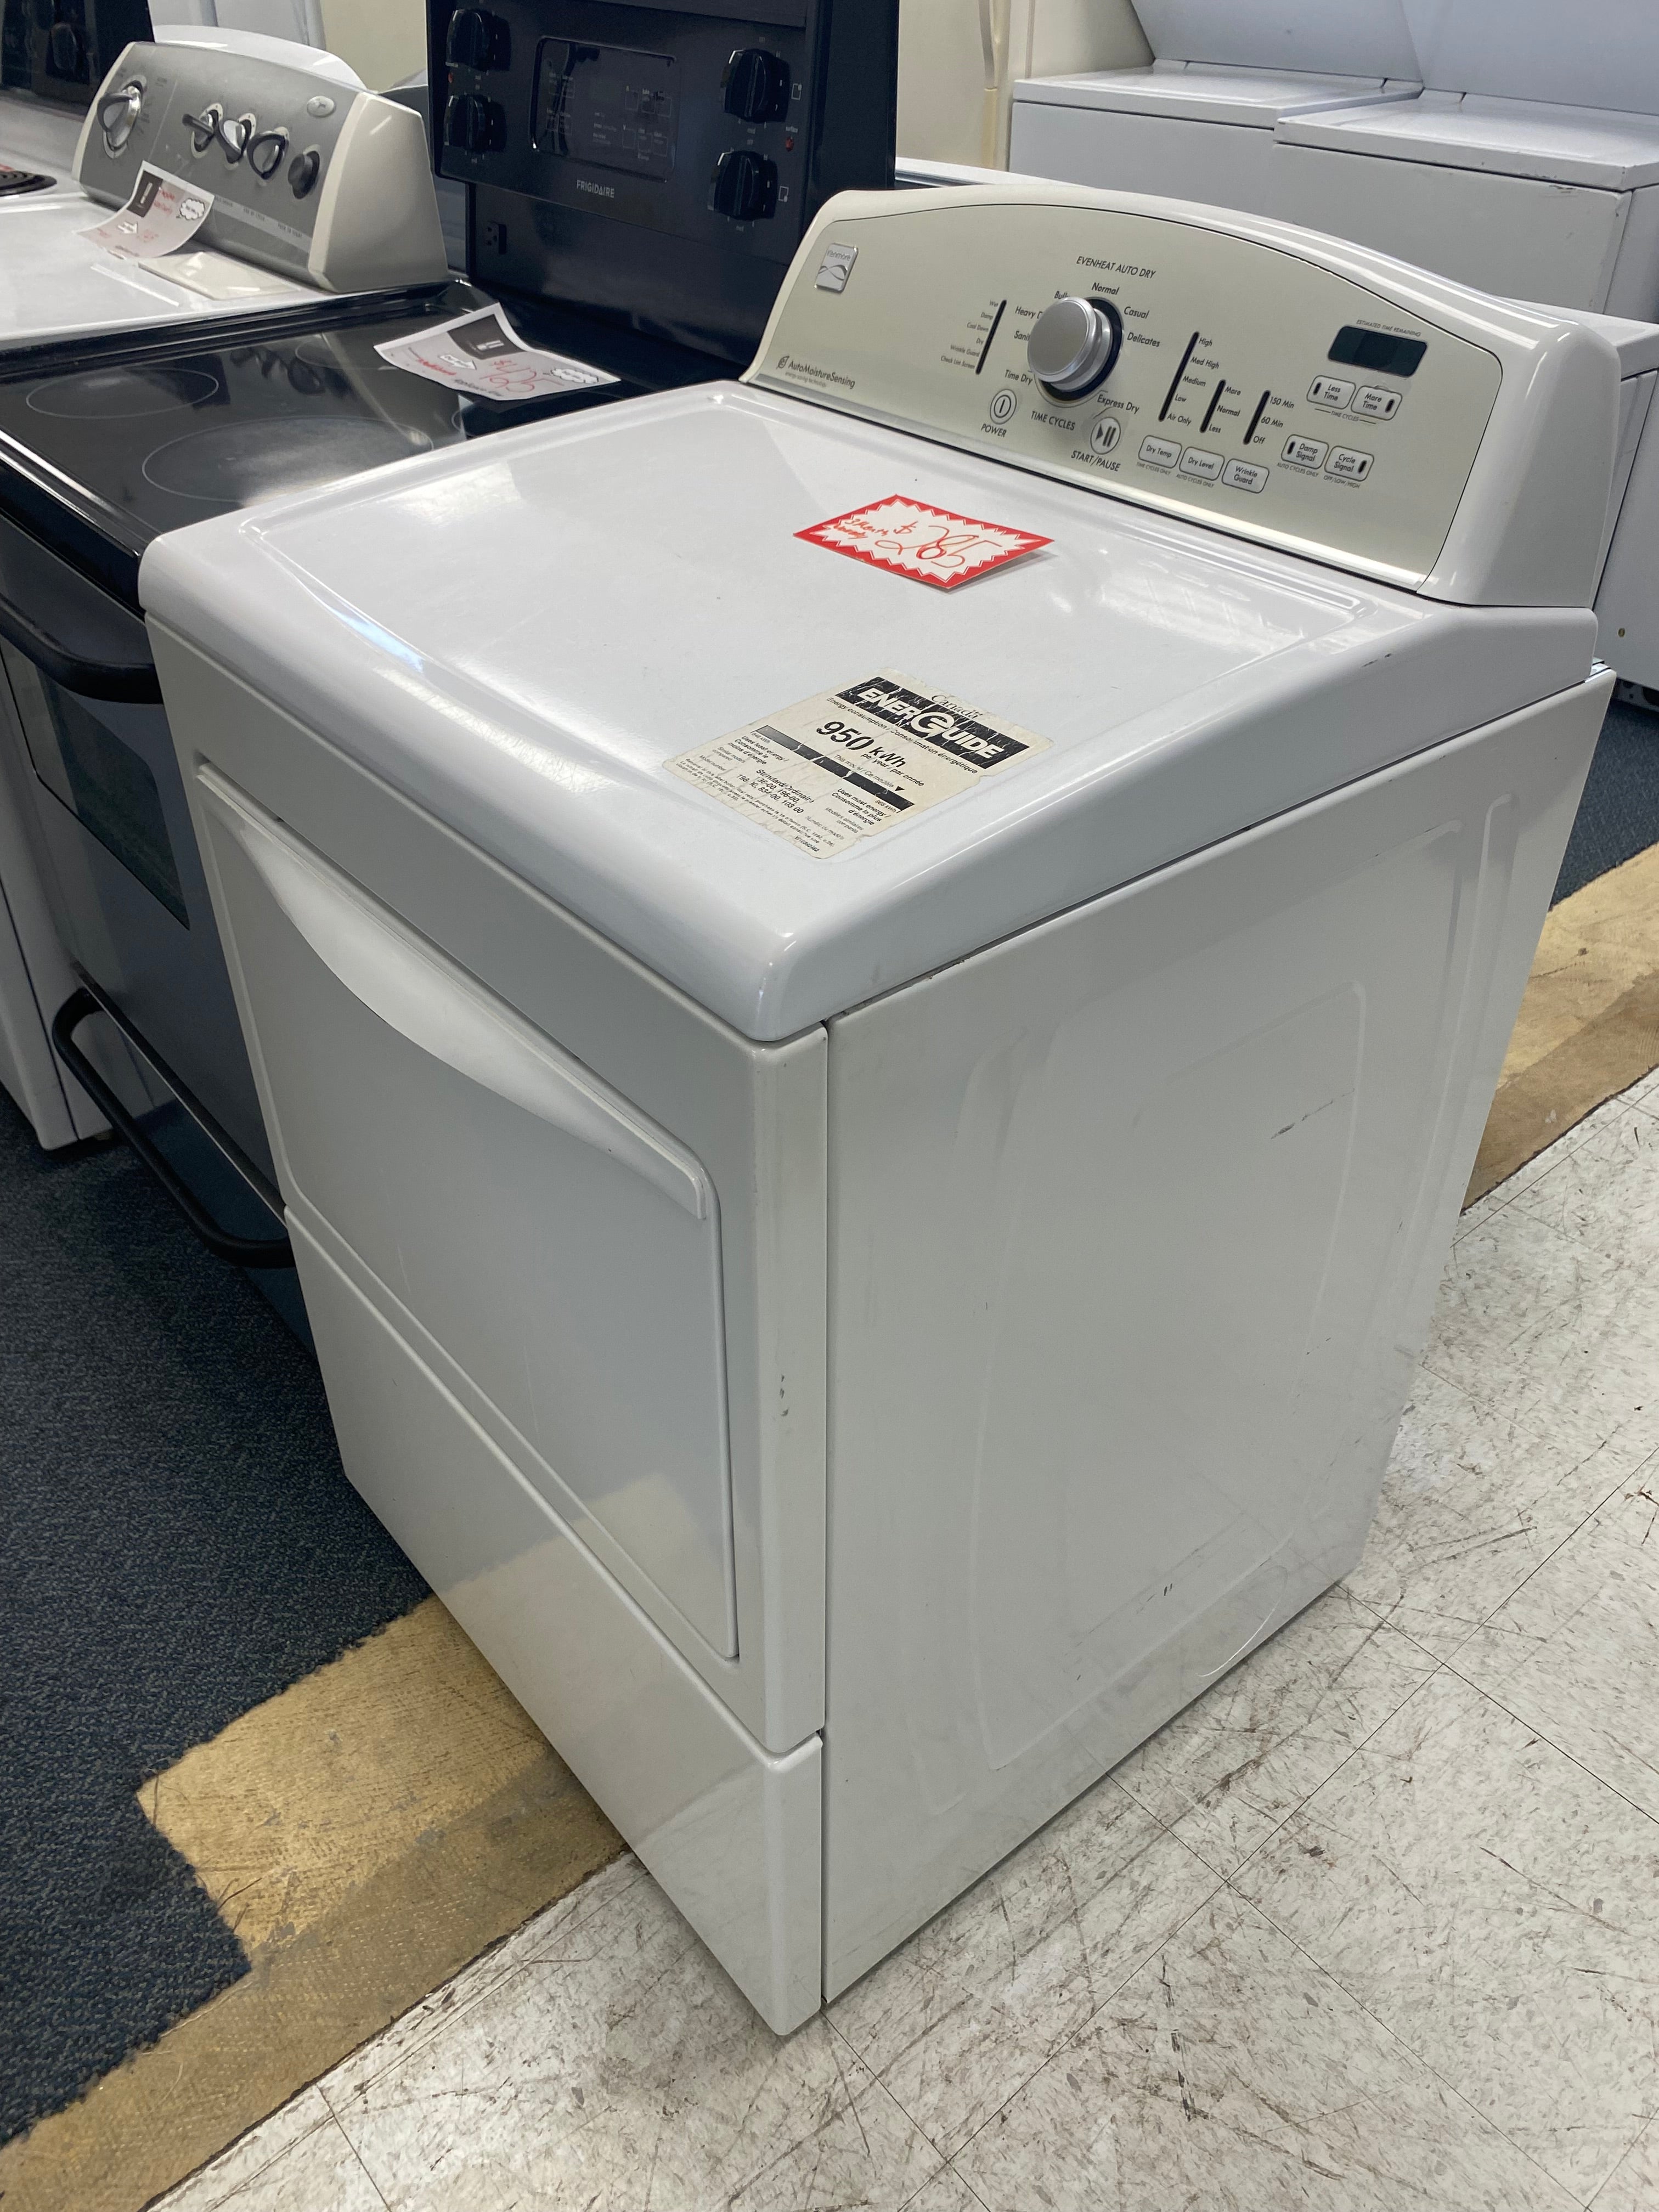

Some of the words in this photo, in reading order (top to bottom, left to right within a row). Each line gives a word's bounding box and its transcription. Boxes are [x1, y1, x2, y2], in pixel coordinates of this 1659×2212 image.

[577, 179, 614, 198] FRIGIDAIRE
[826, 250, 851, 262] Kenmore
[1076, 256, 1116, 271] EVENHEAT
[1115, 264, 1138, 276] AUTO
[1139, 268, 1156, 279] DRY
[1091, 282, 1120, 295] Normal
[1015, 306, 1036, 319] Heavy
[1124, 306, 1149, 319] Casual
[1356, 319, 1381, 329] ESTIMATED
[1381, 324, 1393, 332] TIME
[1393, 328, 1421, 337] REMAINING
[1127, 332, 1160, 347] Delicates
[1199, 337, 1212, 347] High
[1190, 357, 1205, 365] Med
[1205, 359, 1220, 370] High
[788, 360, 856, 390] AutoMoistureSensing
[1004, 369, 1019, 380] Time
[1020, 374, 1034, 386] Dry
[1182, 375, 1206, 387] Medium
[1224, 386, 1241, 396] More
[1328, 384, 1341, 393] Less
[1175, 394, 1187, 403] Low
[1269, 396, 1282, 406] 150
[1282, 399, 1295, 409] Min
[1323, 391, 1339, 402] Time
[1364, 393, 1382, 403] More
[1097, 394, 1124, 409] Express
[1125, 402, 1140, 415] Dry
[1216, 405, 1241, 417] Normal
[1362, 400, 1378, 411] Time
[1031, 410, 1047, 423] TIME
[1048, 416, 1076, 431] CYCLES
[1177, 415, 1192, 426] Only
[1261, 416, 1271, 425] 60
[1270, 418, 1284, 428] Min
[980, 423, 1007, 438] POWER
[1209, 424, 1221, 433] Less
[1253, 436, 1266, 444] Off
[1146, 444, 1156, 454] Dry
[1157, 448, 1172, 458] Temp
[1299, 443, 1318, 455] Damp
[1071, 450, 1121, 472] START/PAUSE
[1296, 450, 1317, 462] Signal
[1338, 453, 1356, 465] Cycle
[1188, 456, 1198, 466] Dry
[1199, 460, 1215, 470] Level
[1334, 461, 1354, 472] Signal
[1235, 466, 1258, 478] Wrinkle
[1233, 473, 1253, 485] Guard
[826, 697, 849, 710] Energy
[847, 708, 888, 729] consumption
[930, 695, 984, 719] Canada
[857, 687, 1005, 759] ENERGUIDE
[741, 735, 755, 744] Uses
[815, 720, 874, 751] 950
[868, 746, 906, 768] kWh
[871, 758, 889, 768] year
[902, 774, 924, 786] année
[831, 792, 863, 811] Consomme
[866, 812, 882, 822] plus
[837, 787, 853, 798] Uses
[850, 796, 867, 806] most
[865, 804, 887, 817] energy
